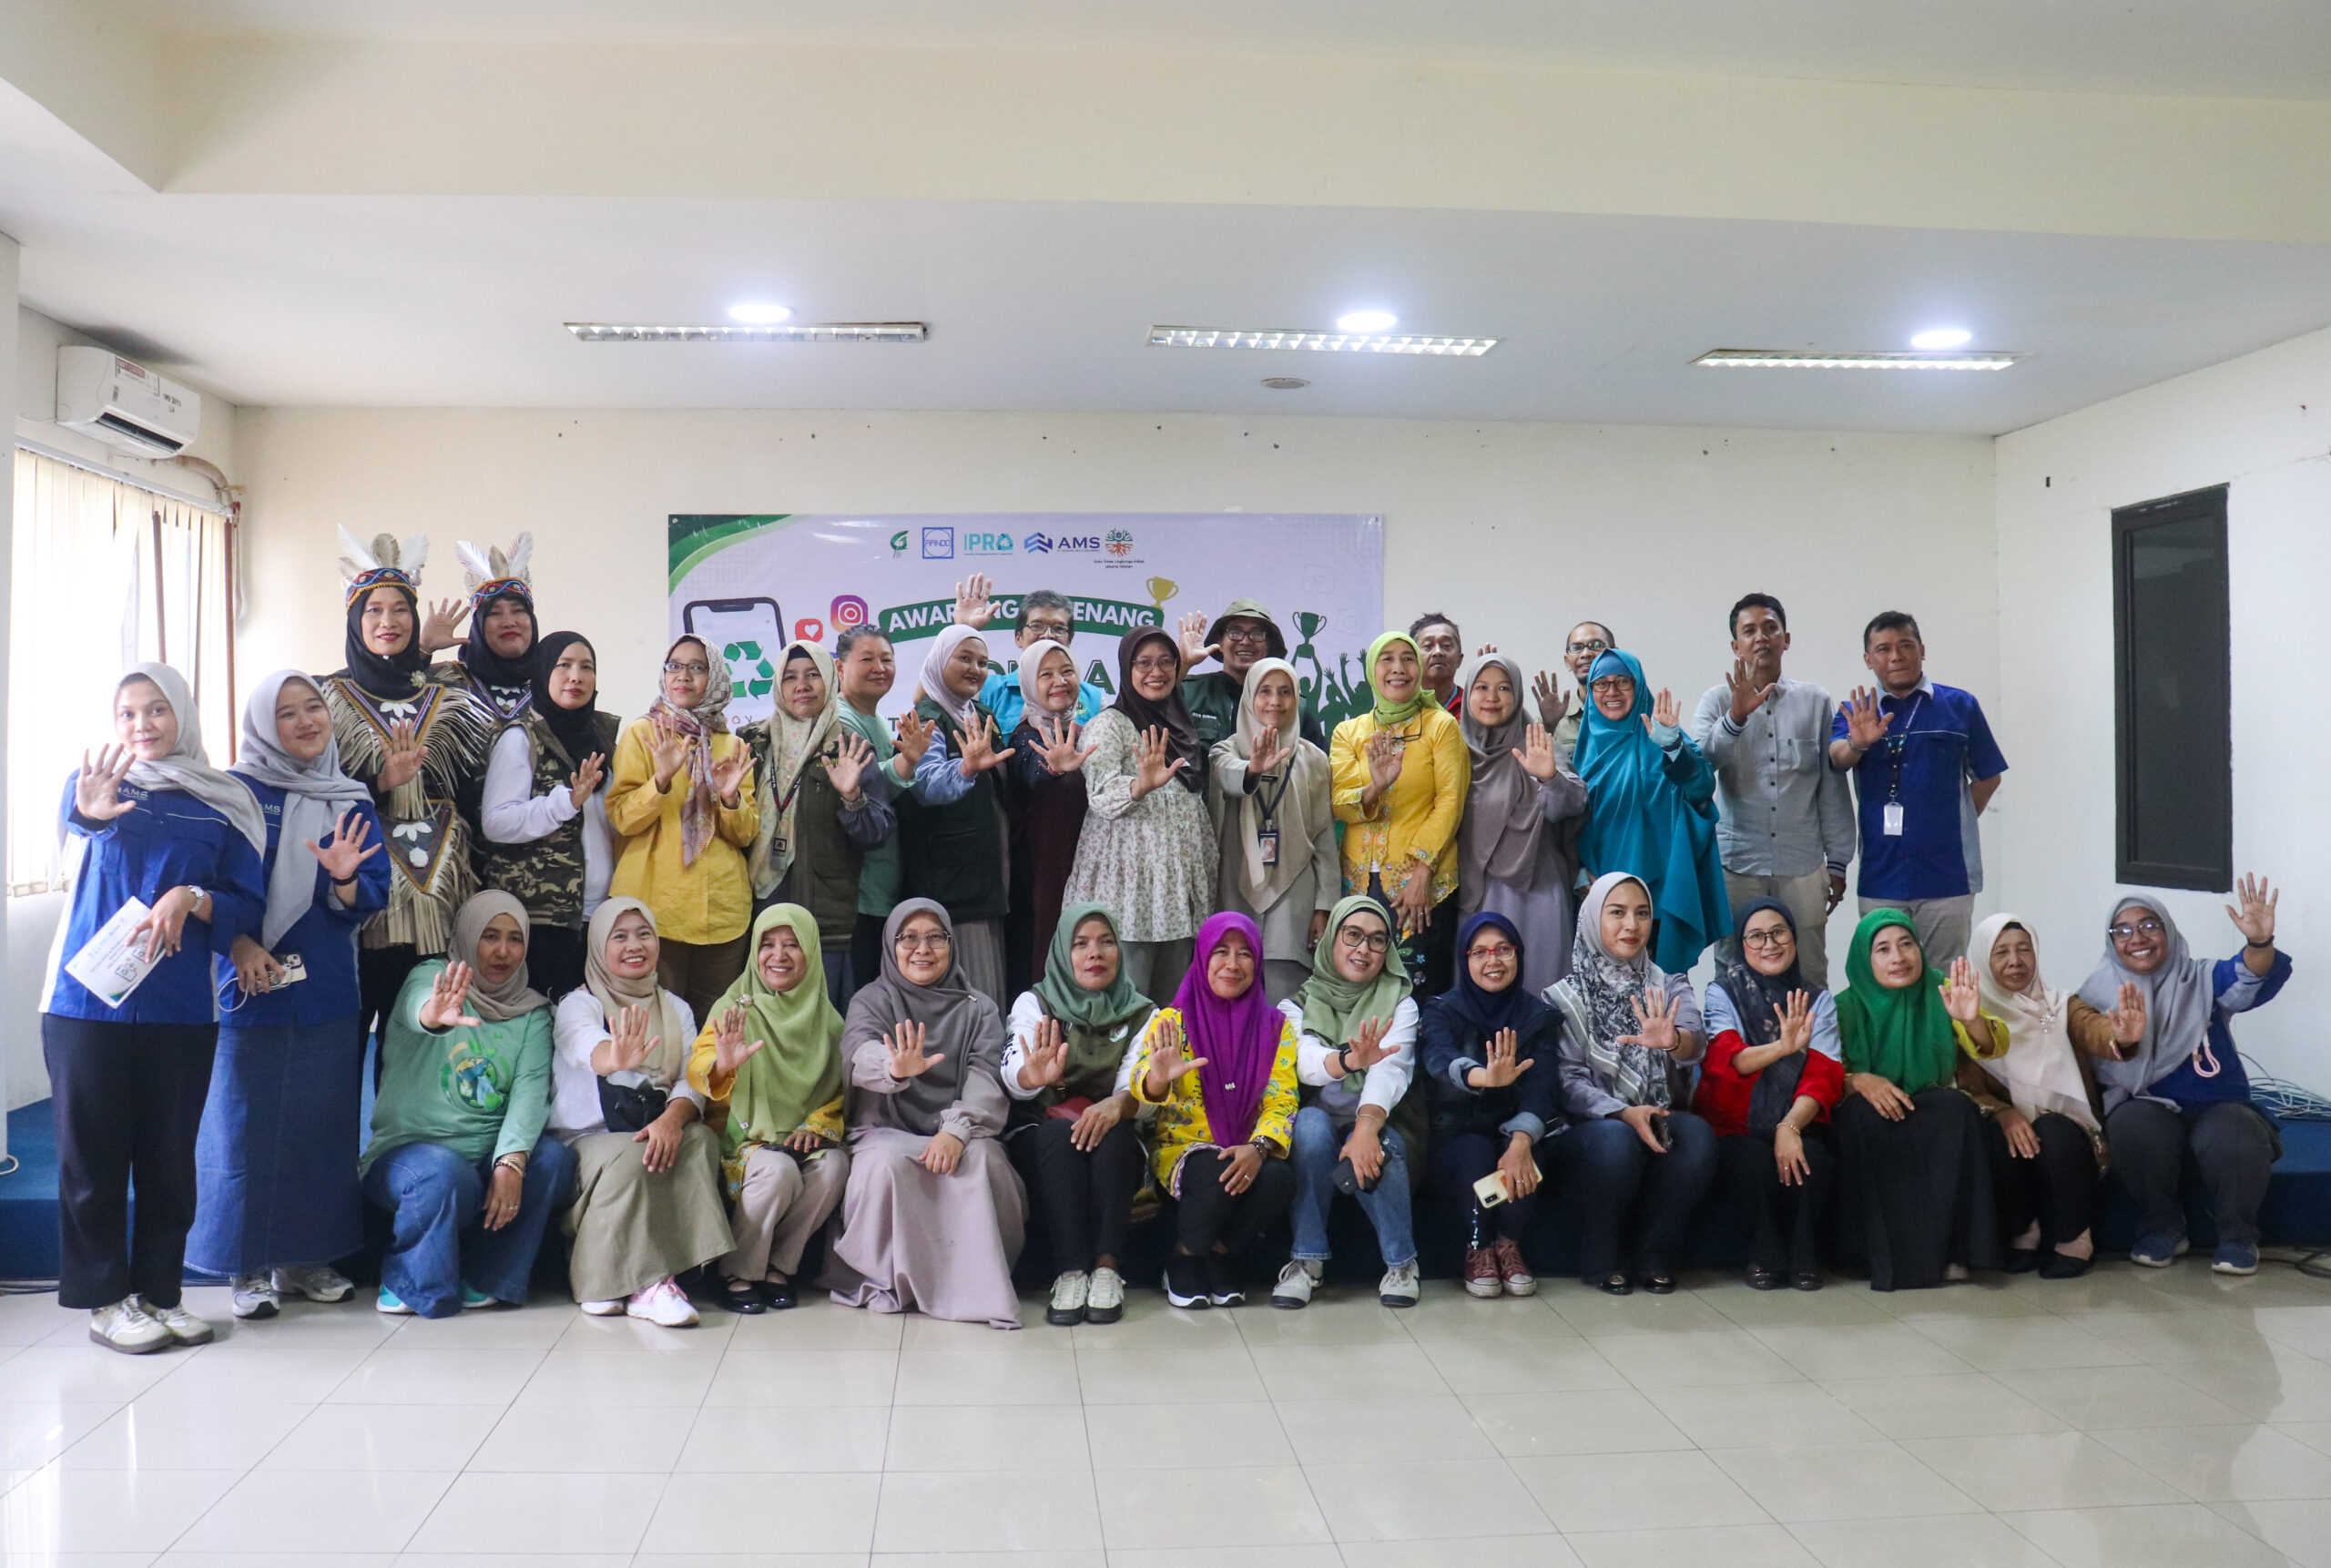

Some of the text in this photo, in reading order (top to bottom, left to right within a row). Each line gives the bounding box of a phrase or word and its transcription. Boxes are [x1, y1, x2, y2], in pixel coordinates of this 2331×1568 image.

[1058, 537, 1100, 549] AMS
[889, 599, 1155, 633] AWARNG ENANG
